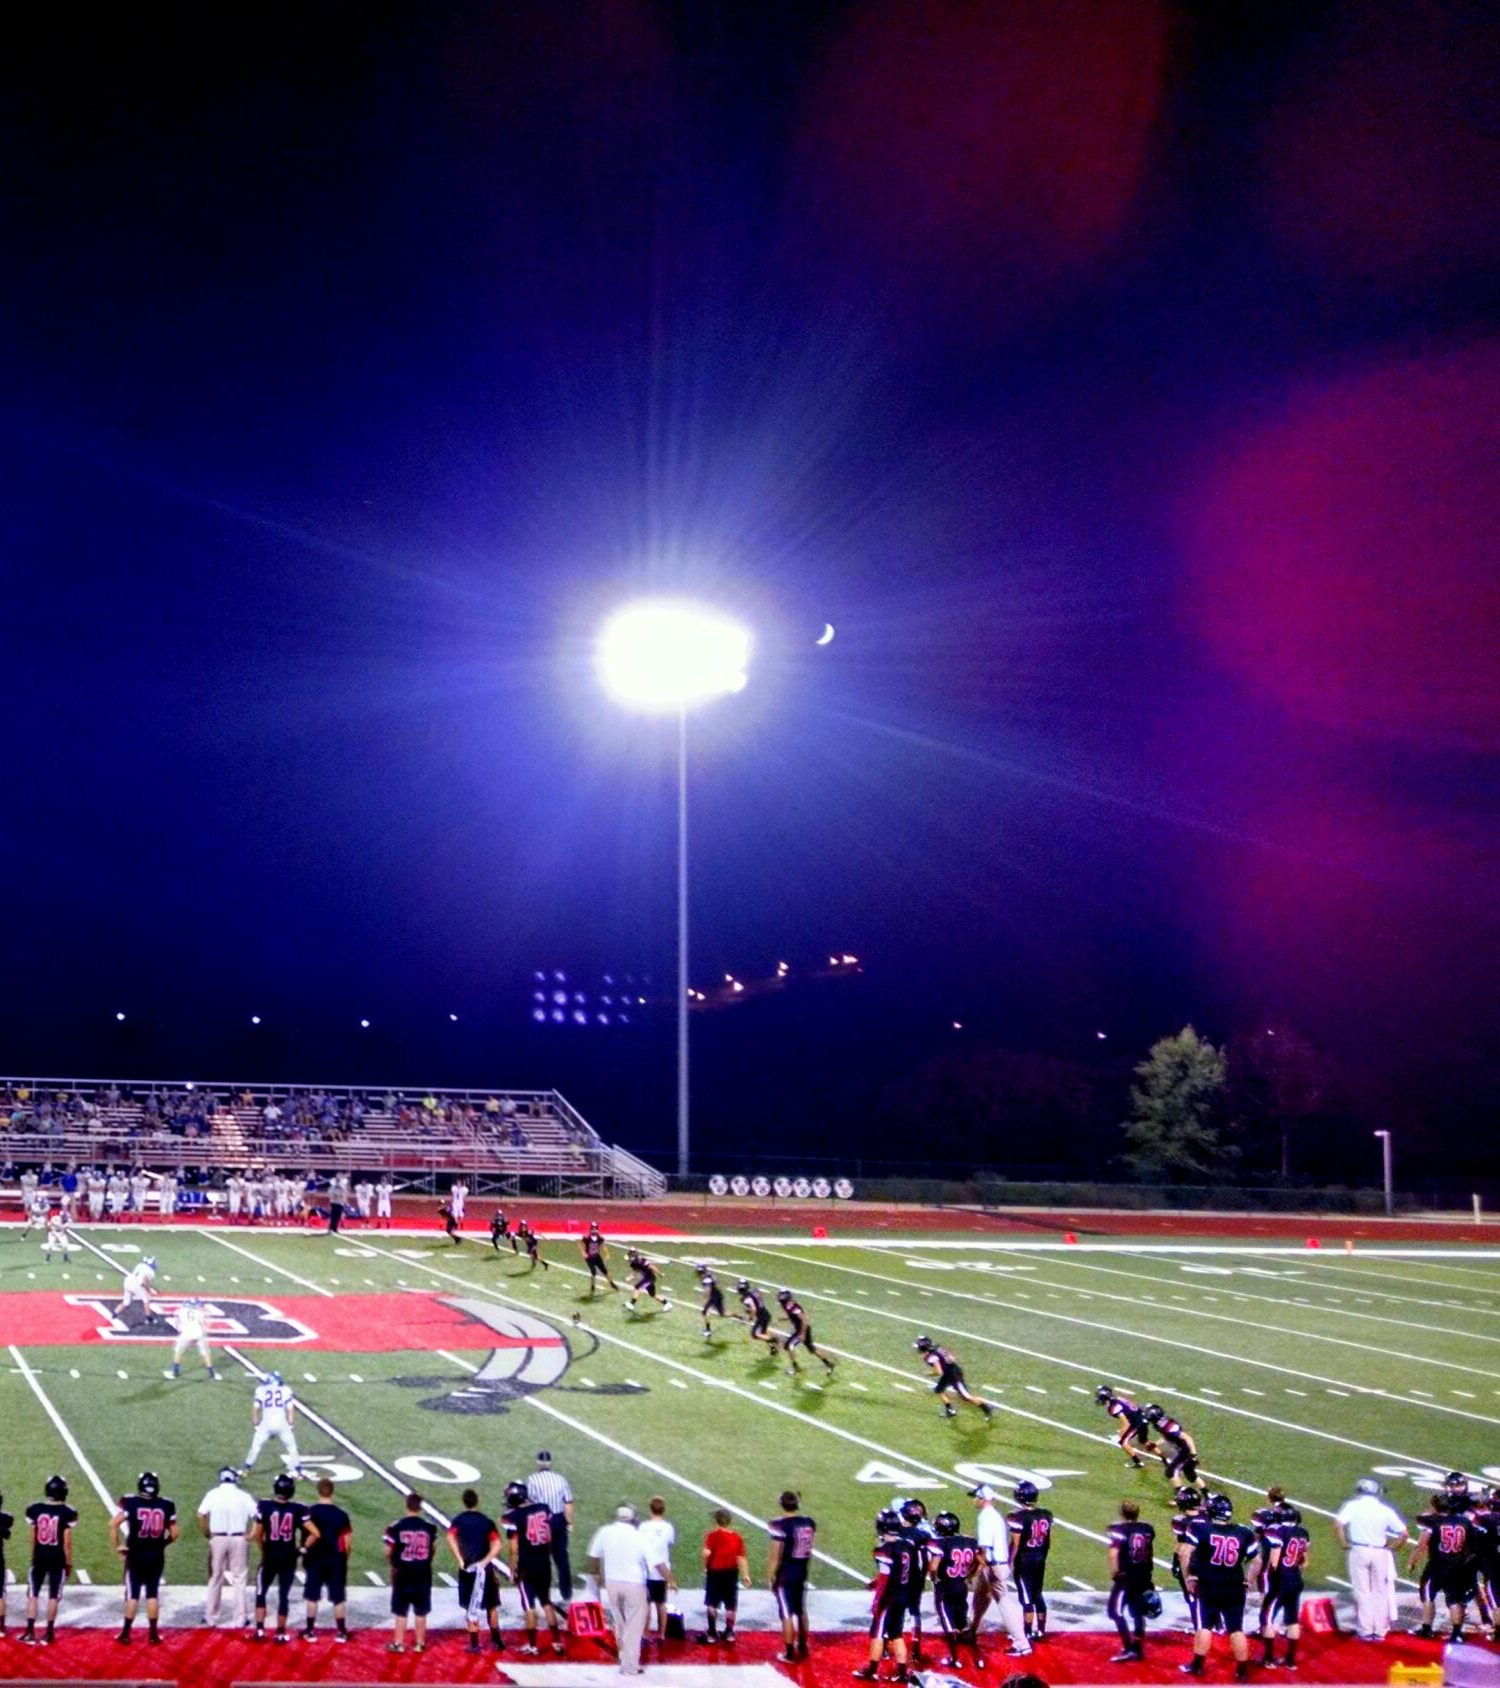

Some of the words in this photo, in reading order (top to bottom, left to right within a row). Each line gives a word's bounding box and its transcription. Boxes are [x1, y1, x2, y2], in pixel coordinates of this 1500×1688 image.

[263, 1390, 284, 1408] 22
[37, 1513, 60, 1546] 81
[137, 1508, 165, 1538] 70
[269, 1513, 294, 1542] 14
[526, 1511, 550, 1546] 45
[1210, 1534, 1240, 1567] 76
[573, 1610, 604, 1635] 50
